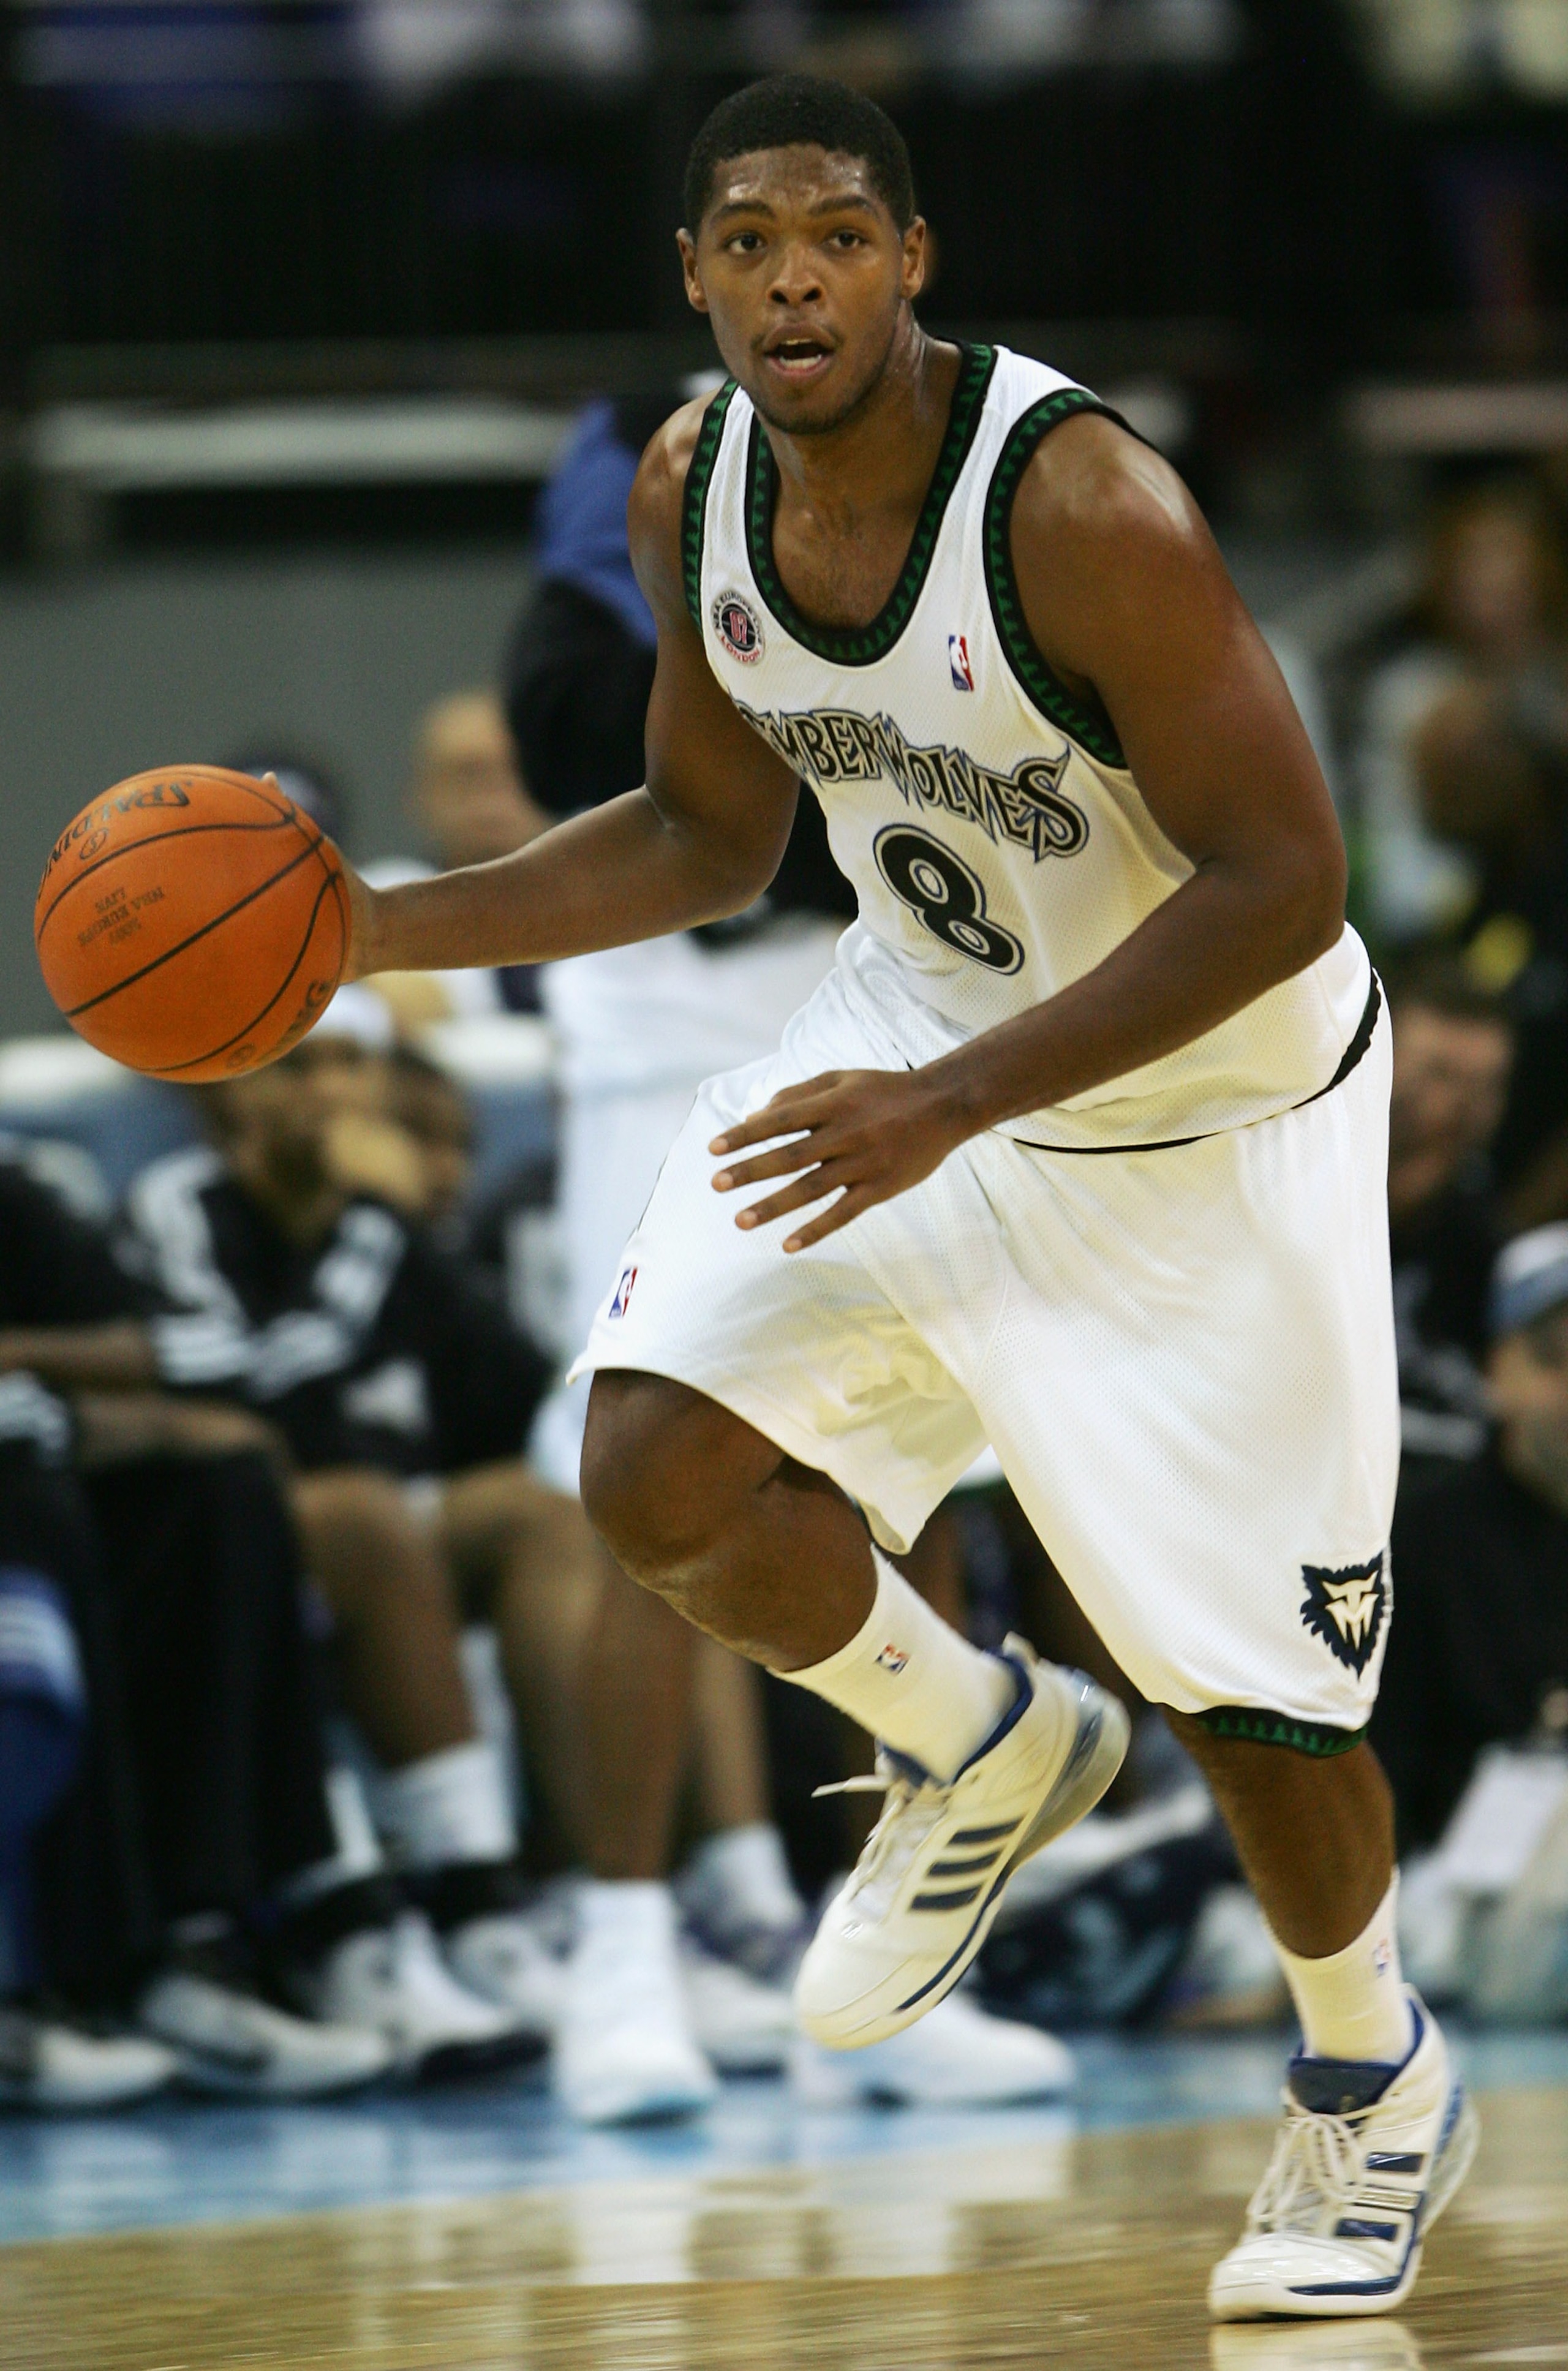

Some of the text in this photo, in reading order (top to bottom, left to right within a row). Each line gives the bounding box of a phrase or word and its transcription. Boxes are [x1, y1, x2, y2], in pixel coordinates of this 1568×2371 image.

[720, 635, 760, 663] LONDON
[734, 699, 1090, 864] MBERWOLVES
[872, 823, 1025, 976] 8
